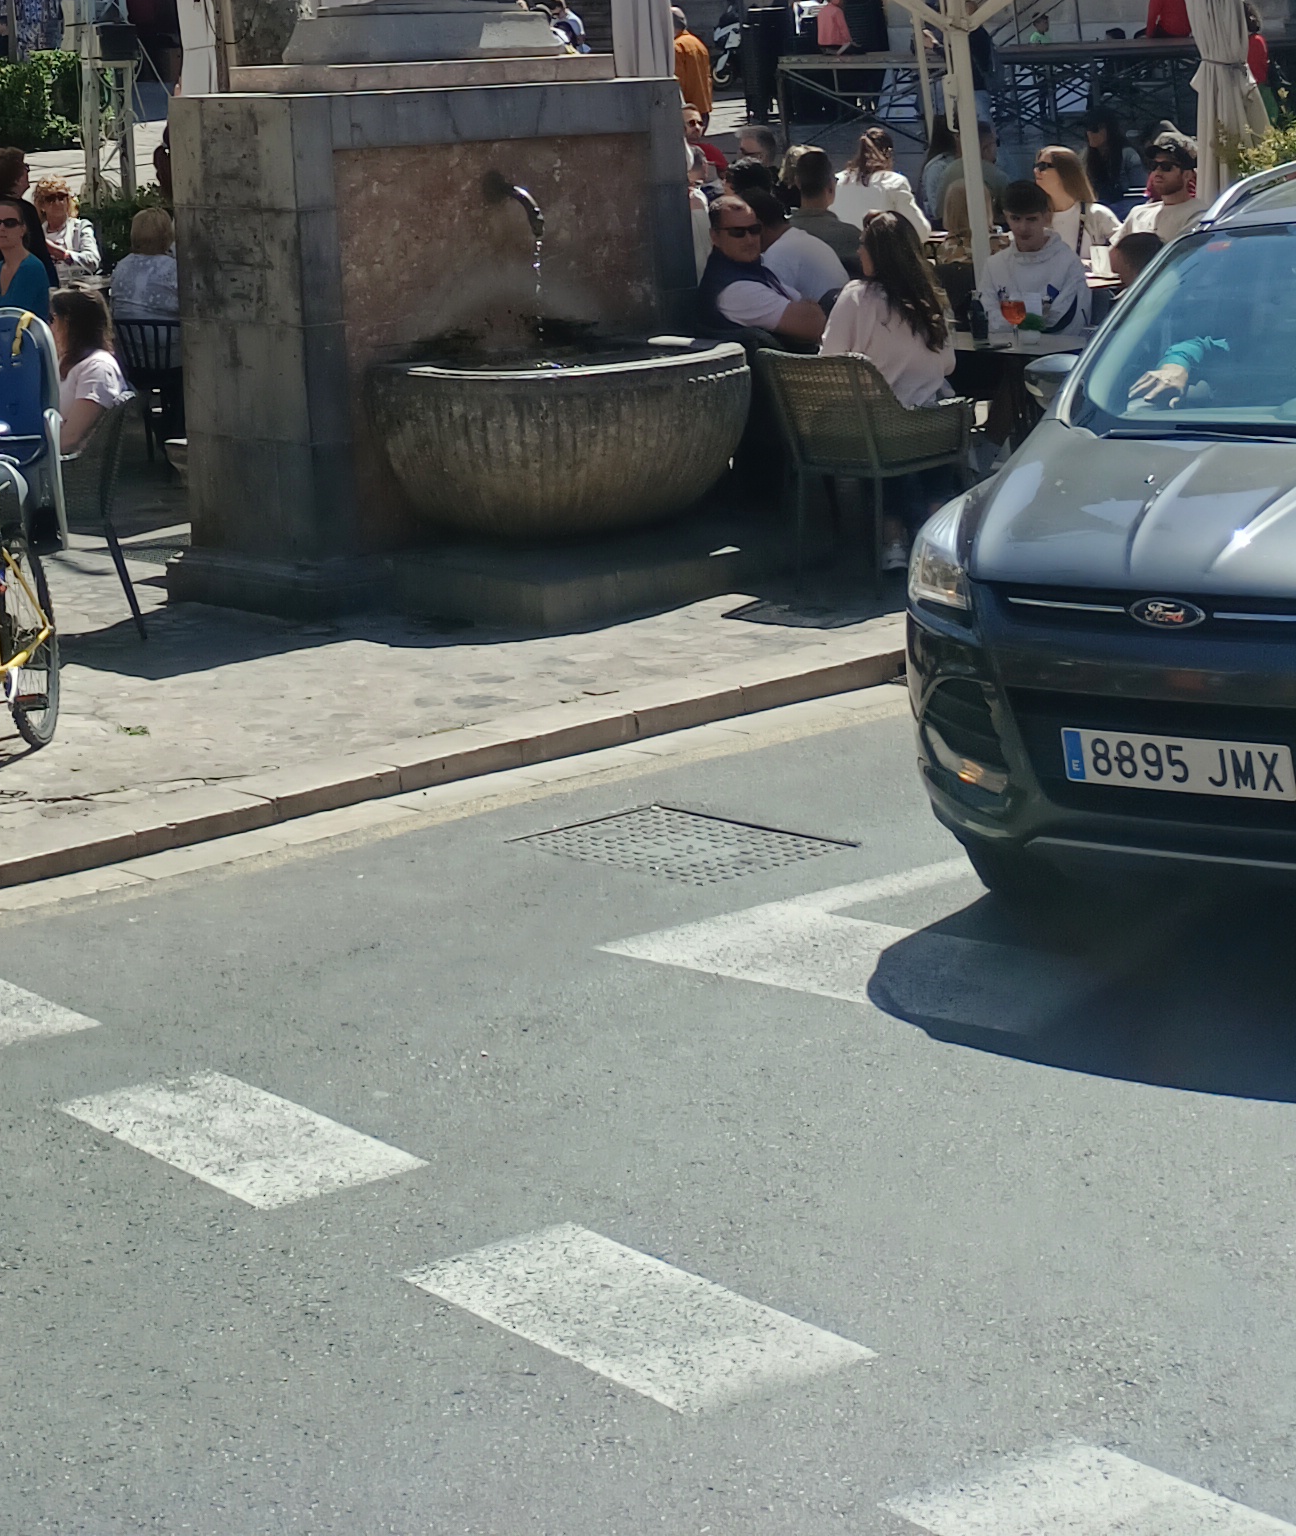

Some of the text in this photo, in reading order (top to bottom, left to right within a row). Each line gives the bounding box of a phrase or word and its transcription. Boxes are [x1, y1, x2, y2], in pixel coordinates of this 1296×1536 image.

[1072, 738, 1284, 792] E 8895 JMX
